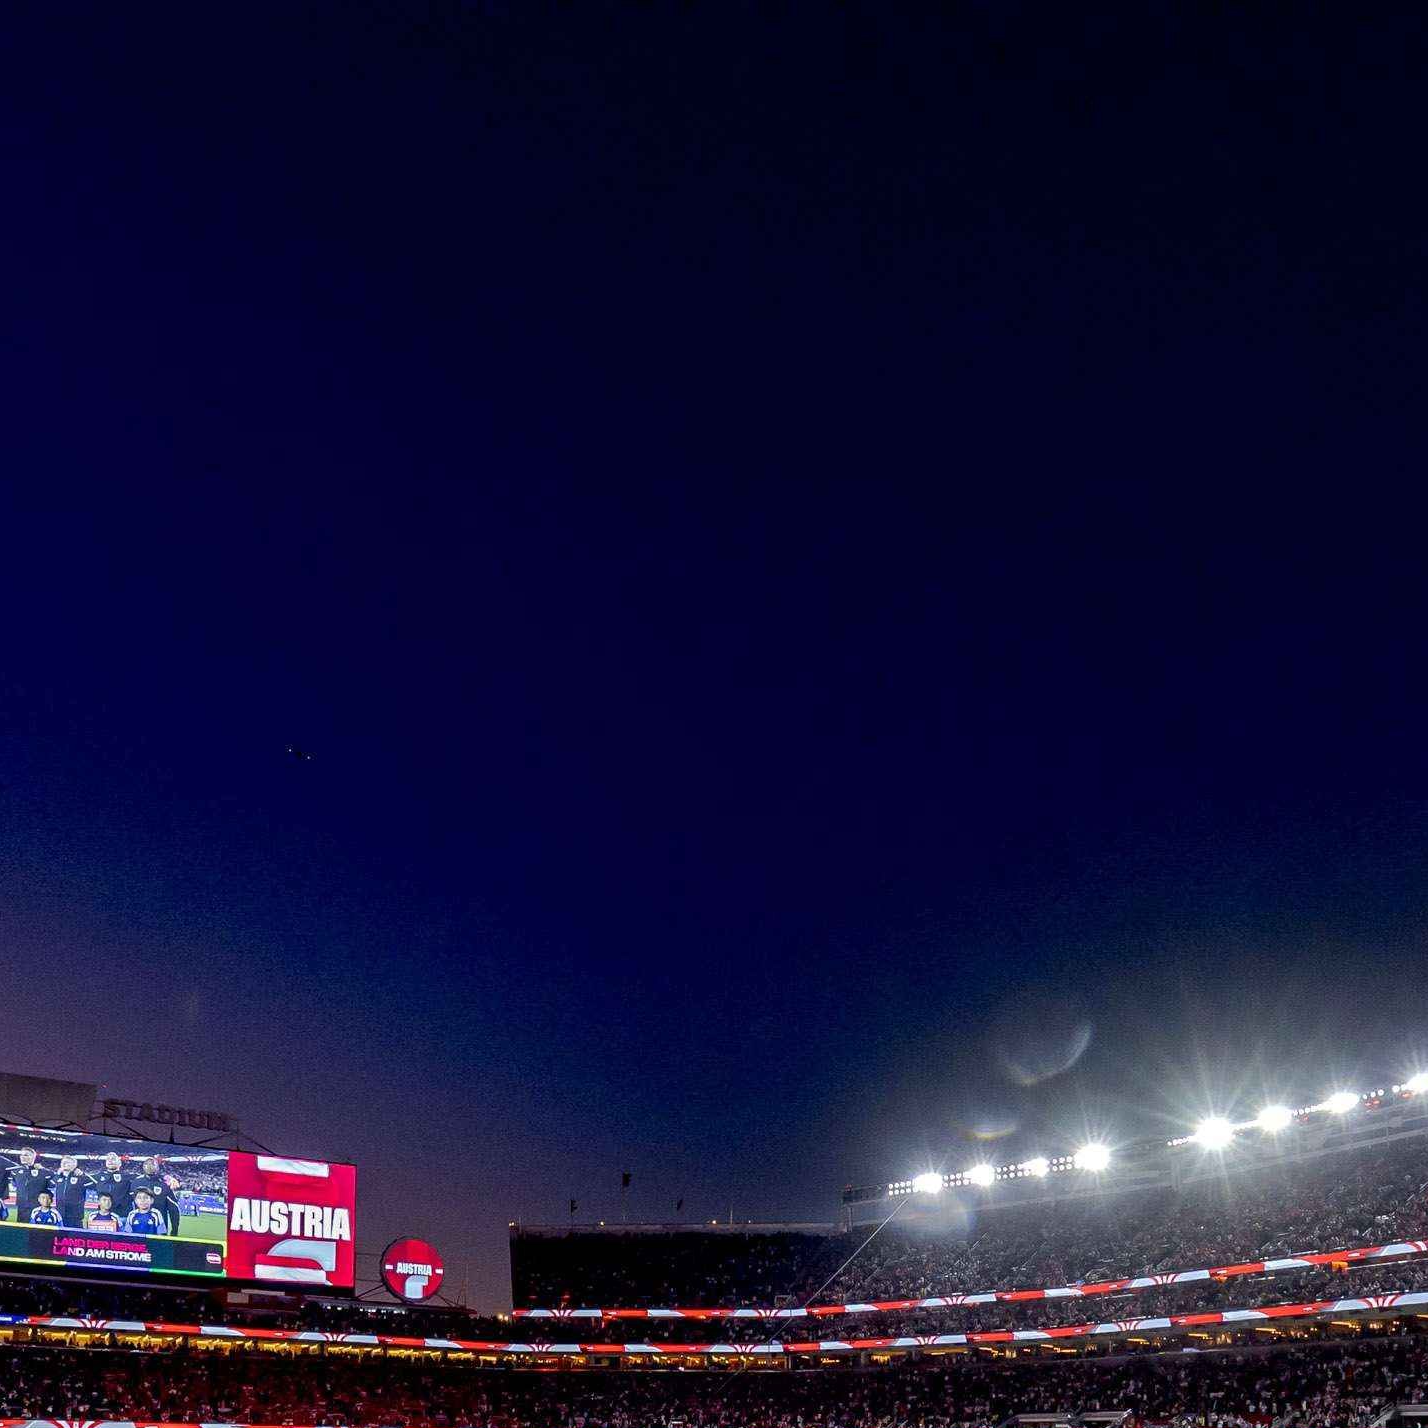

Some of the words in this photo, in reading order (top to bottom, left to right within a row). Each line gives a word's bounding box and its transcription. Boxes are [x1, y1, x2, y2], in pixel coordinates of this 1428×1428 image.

[229, 1196, 351, 1241] AUSTRIA
[53, 1245, 85, 1257] LAND
[85, 1248, 106, 1259] AM
[106, 1250, 153, 1262] STROME
[396, 1262, 432, 1276] AUSTRIA
